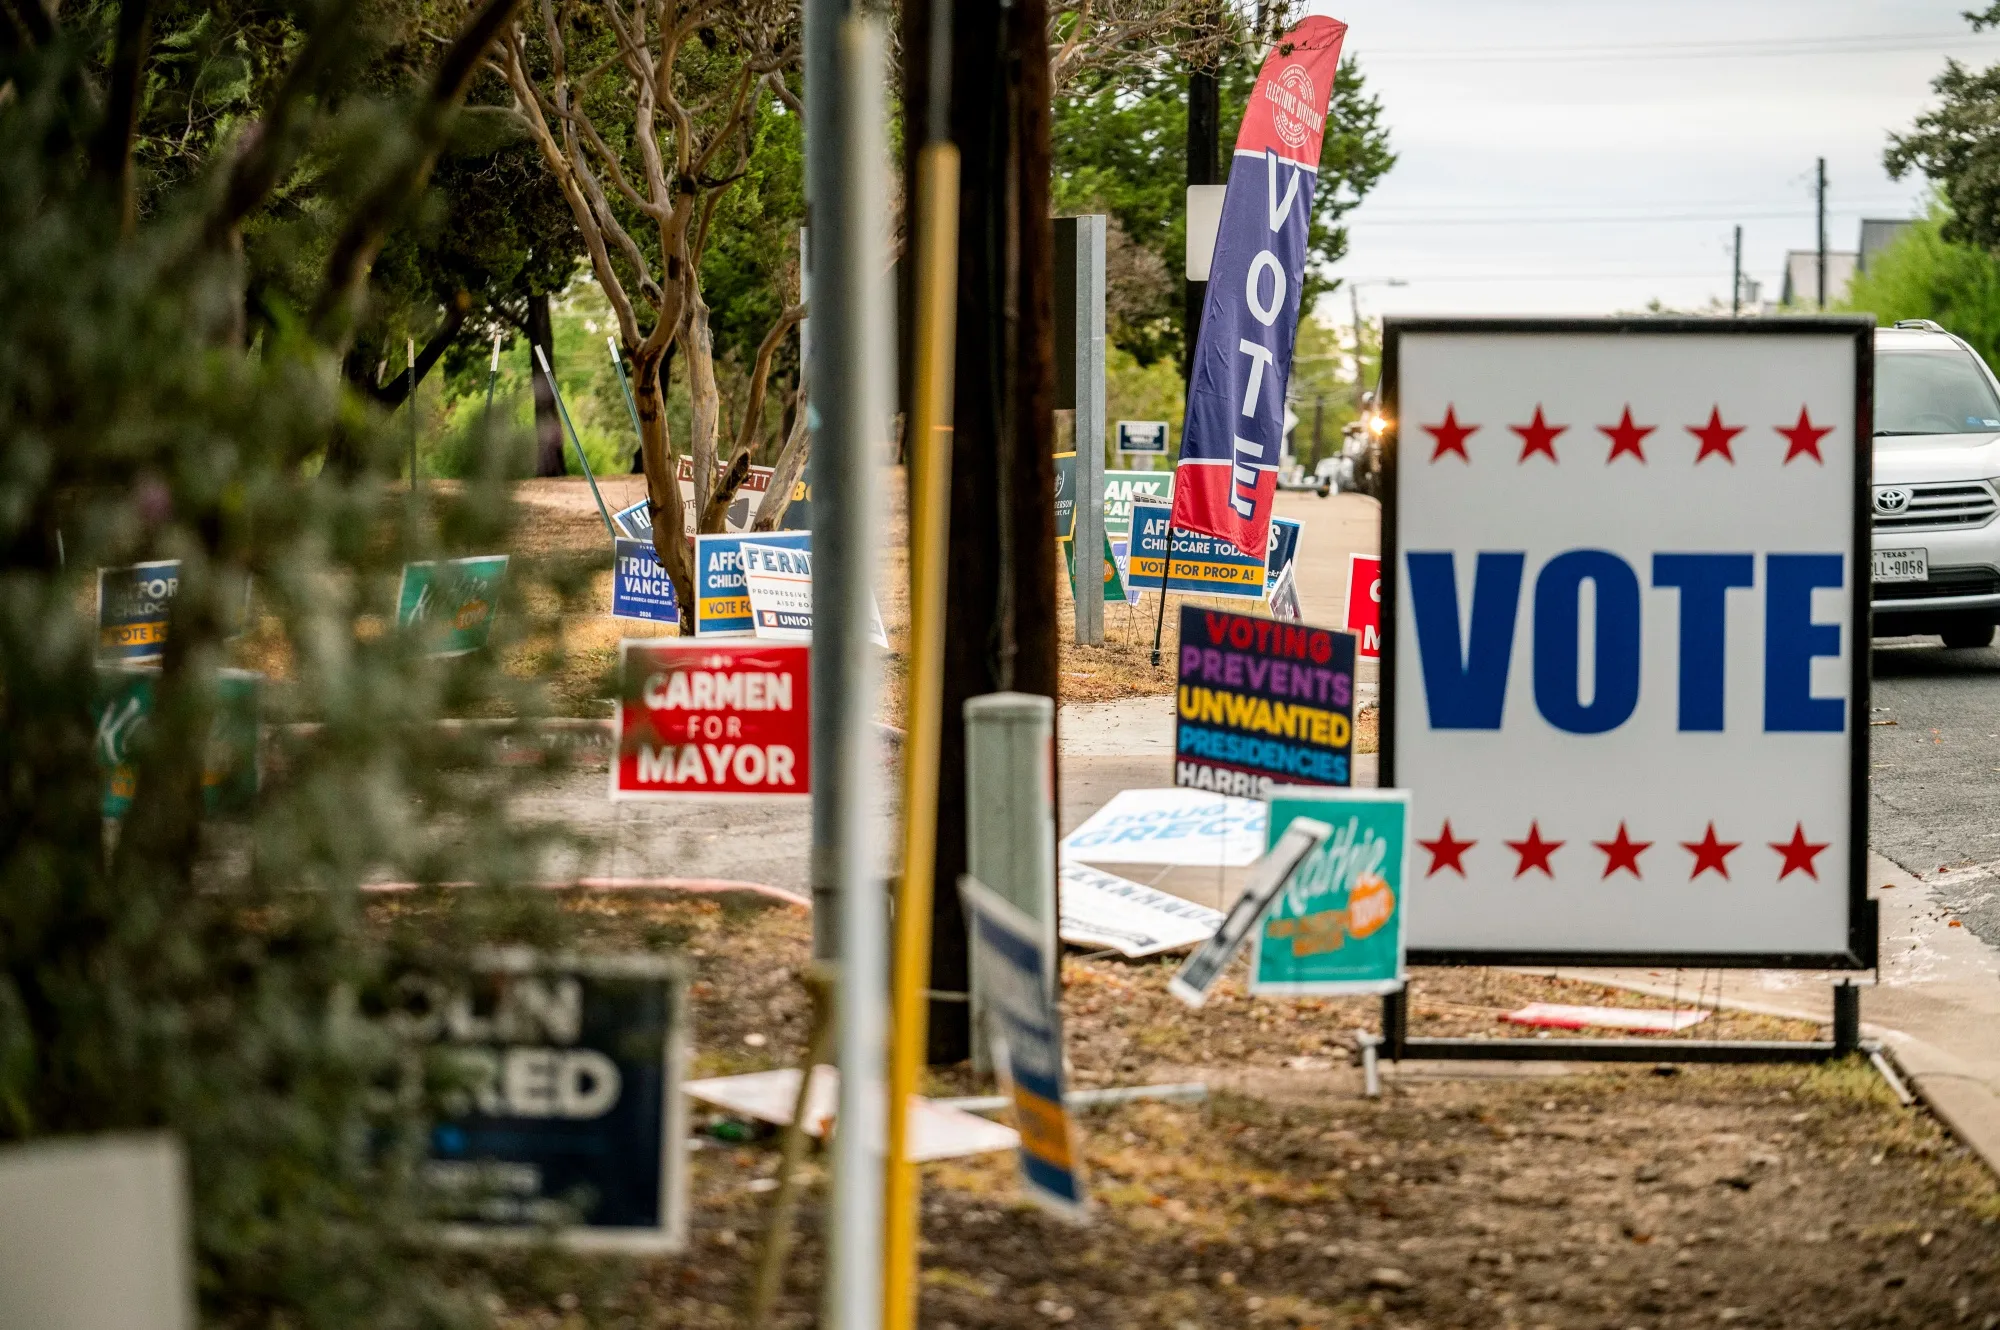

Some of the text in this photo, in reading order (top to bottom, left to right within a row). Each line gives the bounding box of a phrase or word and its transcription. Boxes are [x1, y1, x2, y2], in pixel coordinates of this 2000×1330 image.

[1265, 80, 1323, 133] ELECTIONS DIVISION
[1231, 151, 1301, 516] VOTE
[619, 556, 670, 580] TRUM
[745, 547, 812, 575] FERN
[1175, 564, 1199, 577] FOR
[1204, 566, 1238, 579] PROP
[1242, 569, 1254, 580] A!
[625, 577, 670, 597] VANCE
[709, 600, 752, 614] VOTE FO
[752, 588, 808, 599] PROGRESSIVE
[1205, 611, 1333, 664] VOTING
[1406, 547, 1847, 735] VOTE
[643, 670, 793, 711] CARMEN
[1180, 644, 1351, 707] PREVENTS
[686, 715, 743, 740] FOR
[1178, 684, 1351, 748] UNWANTED
[636, 743, 796, 786] MAYOR
[1179, 724, 1349, 784] PRESIDENCIES
